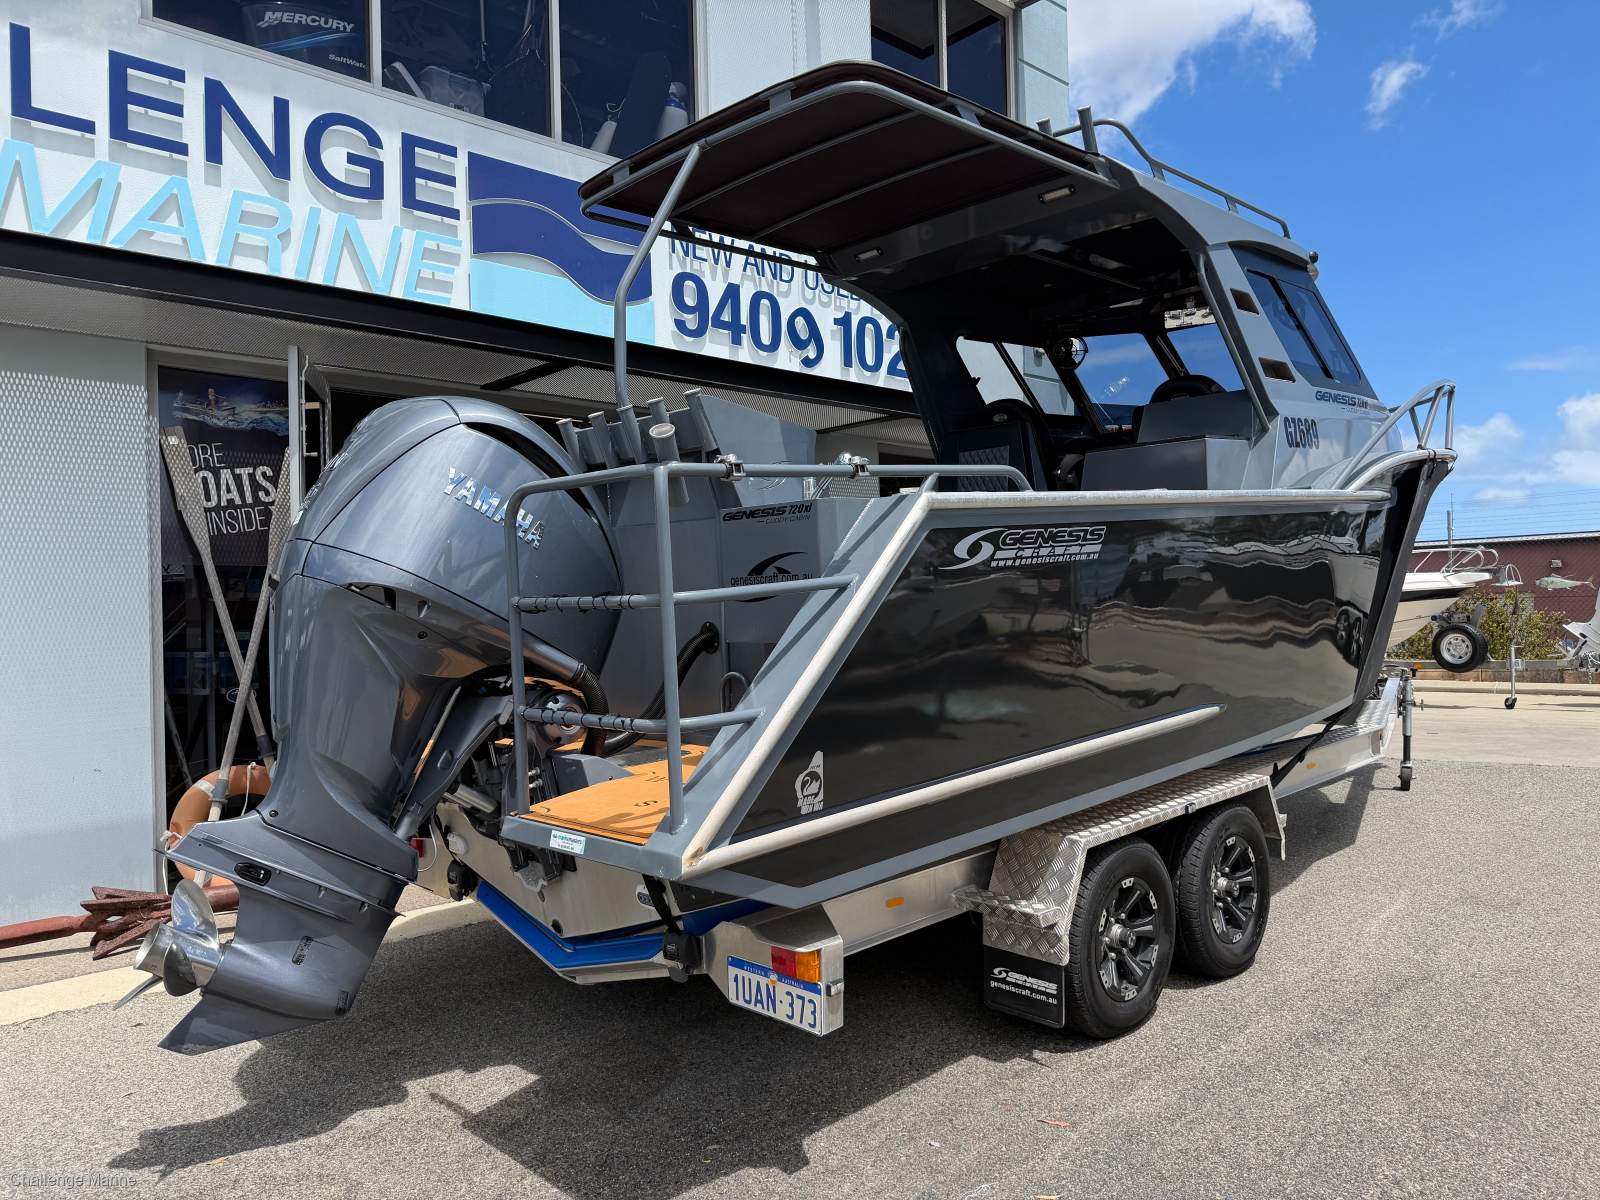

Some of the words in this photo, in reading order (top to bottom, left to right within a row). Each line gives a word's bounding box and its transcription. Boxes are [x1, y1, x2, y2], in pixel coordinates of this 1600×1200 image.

[258, 11, 354, 33] MERCURY
[10, 22, 460, 221] LENGE
[0, 138, 463, 305] MARINE
[671, 227, 734, 268] NEW
[743, 243, 795, 284] AND
[671, 272, 825, 369] 9409
[1315, 391, 1357, 407] GENESIS
[187, 443, 225, 469] ORE
[196, 465, 279, 508] OATS
[206, 507, 269, 536] INSIDE
[723, 505, 787, 522] GENESIS
[1000, 526, 1107, 549] GENESIS
[990, 553, 1099, 568] www.genesiscraft.com.au
[730, 572, 813, 588] genesiscraftcomau
[990, 980, 1058, 1005] genesiscraft.com.au
